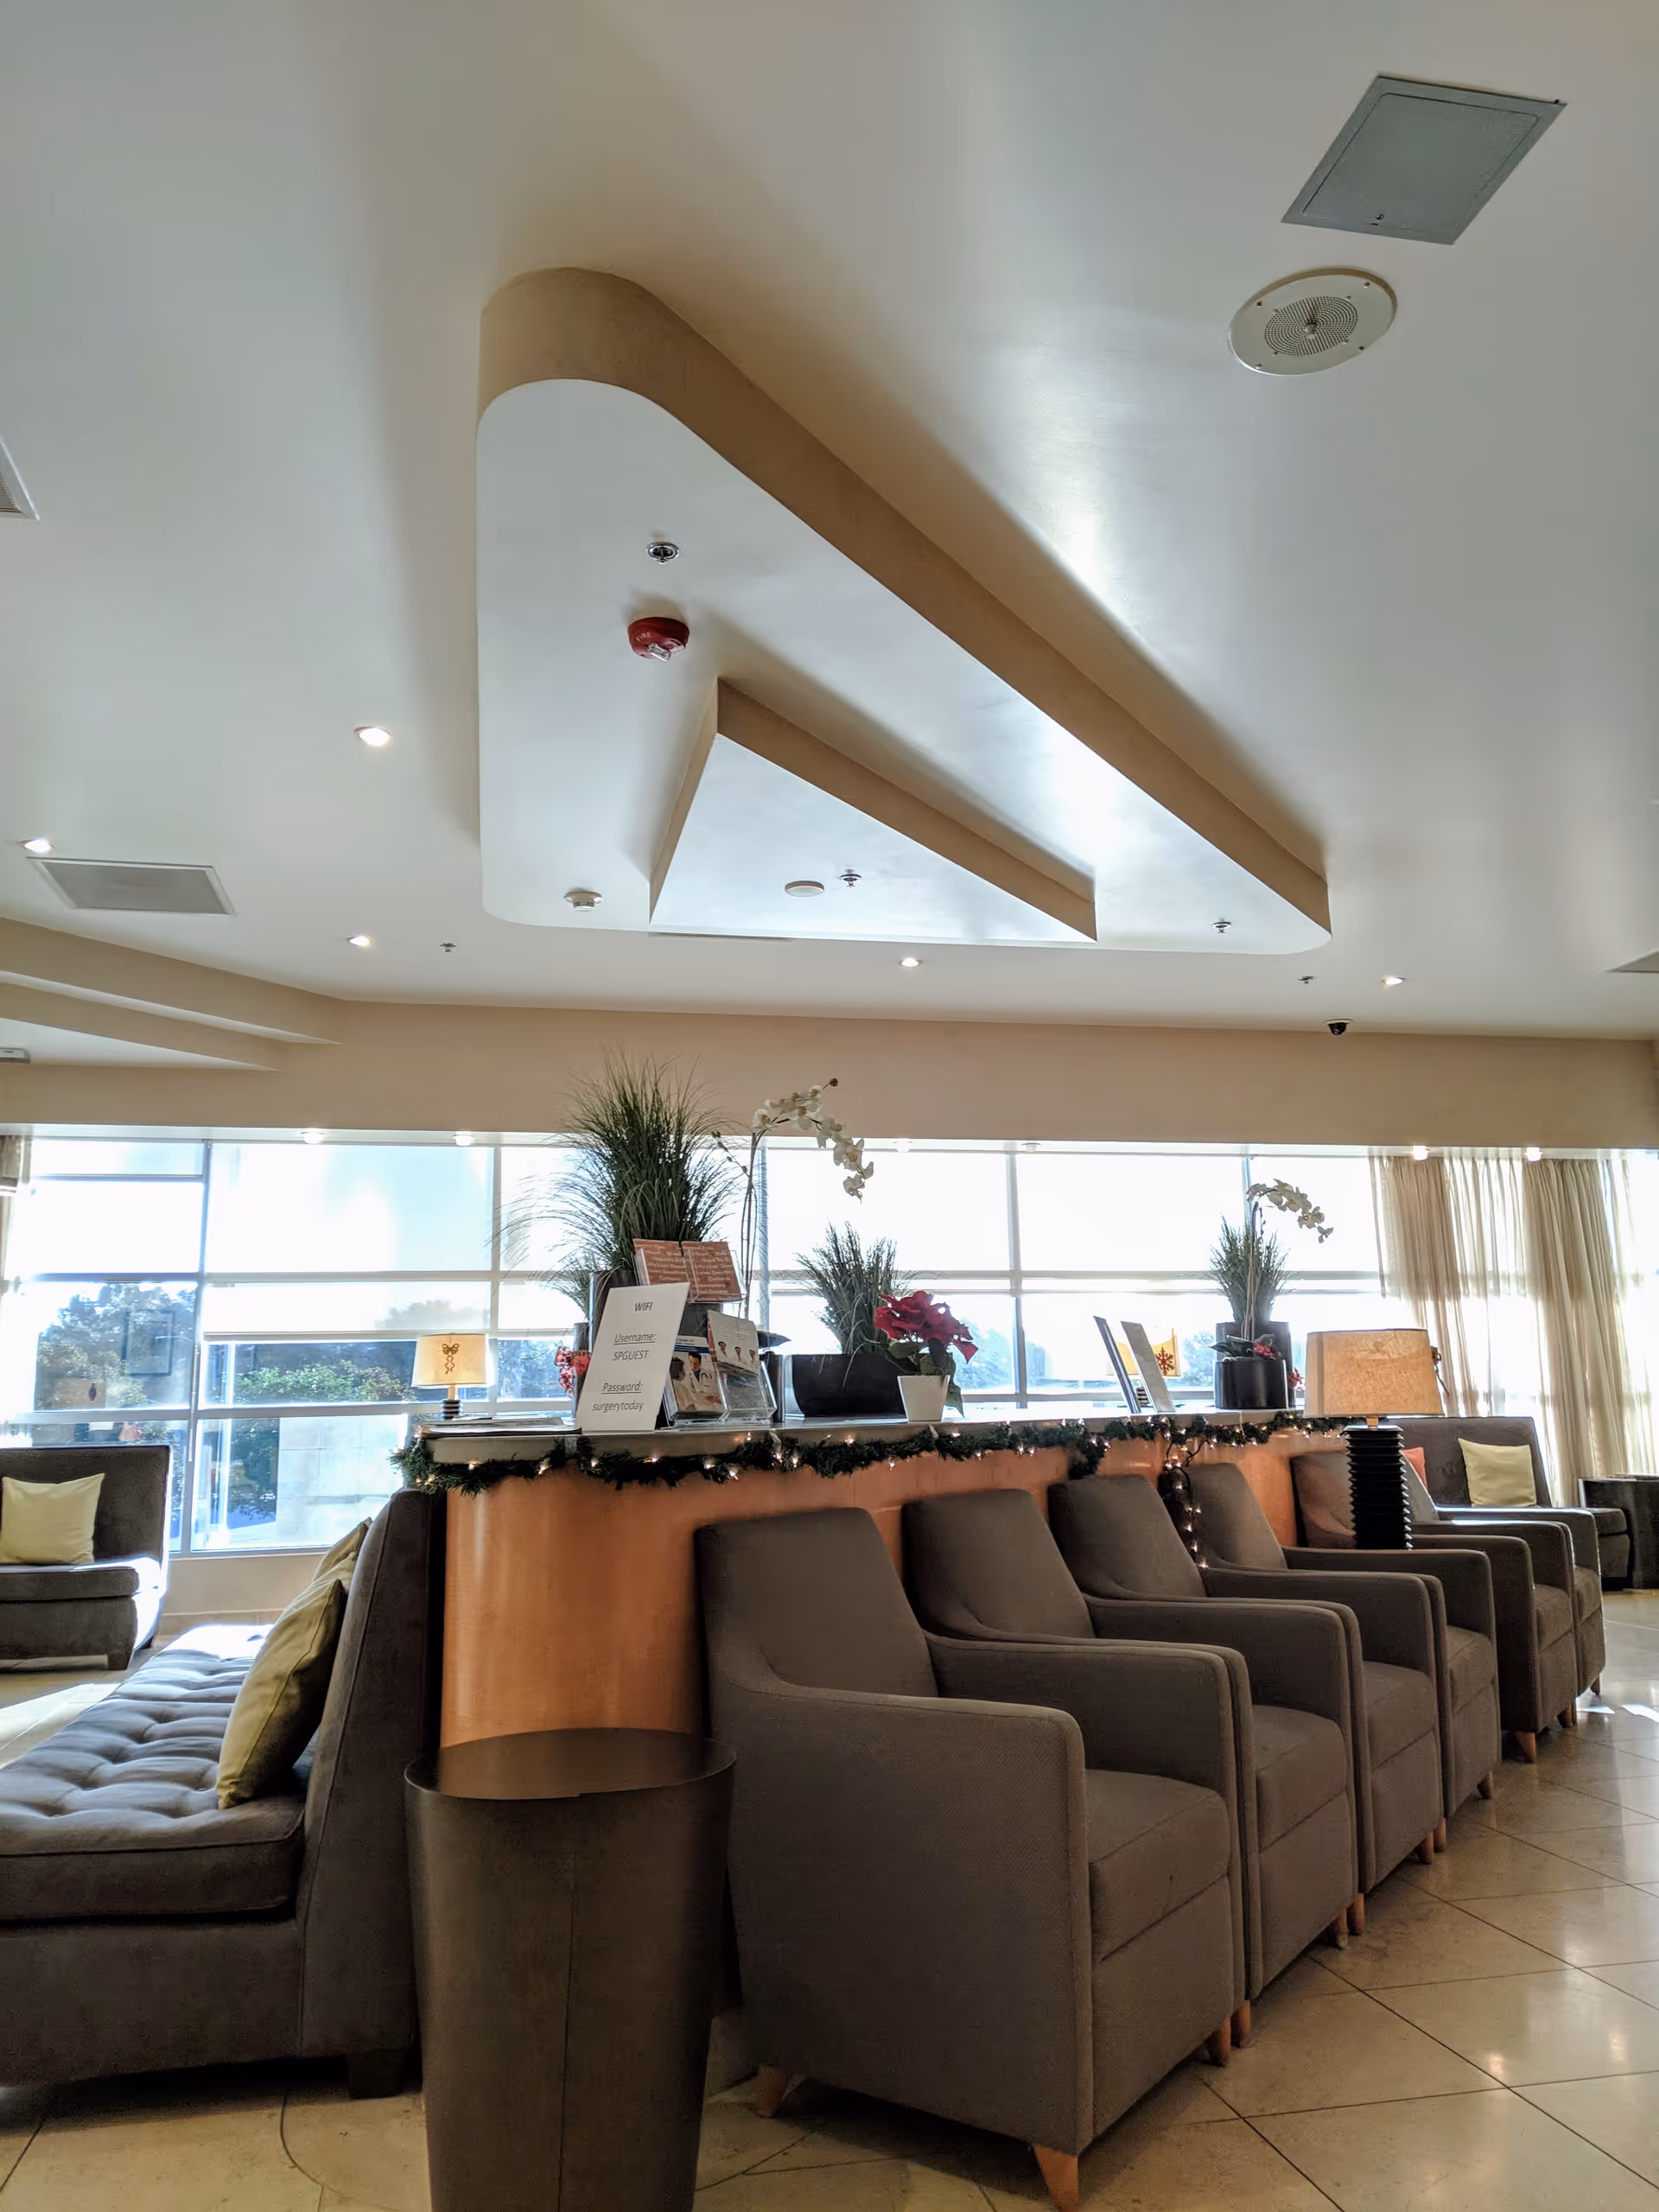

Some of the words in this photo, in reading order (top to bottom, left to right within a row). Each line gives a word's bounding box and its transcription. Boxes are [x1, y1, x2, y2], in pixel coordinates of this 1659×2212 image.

[635, 632, 652, 643] FIRE
[614, 1333, 657, 1343] Username:
[613, 1350, 650, 1361] SPGUEST
[602, 1382, 644, 1392] Password:
[592, 1401, 645, 1413] surgerytoday
